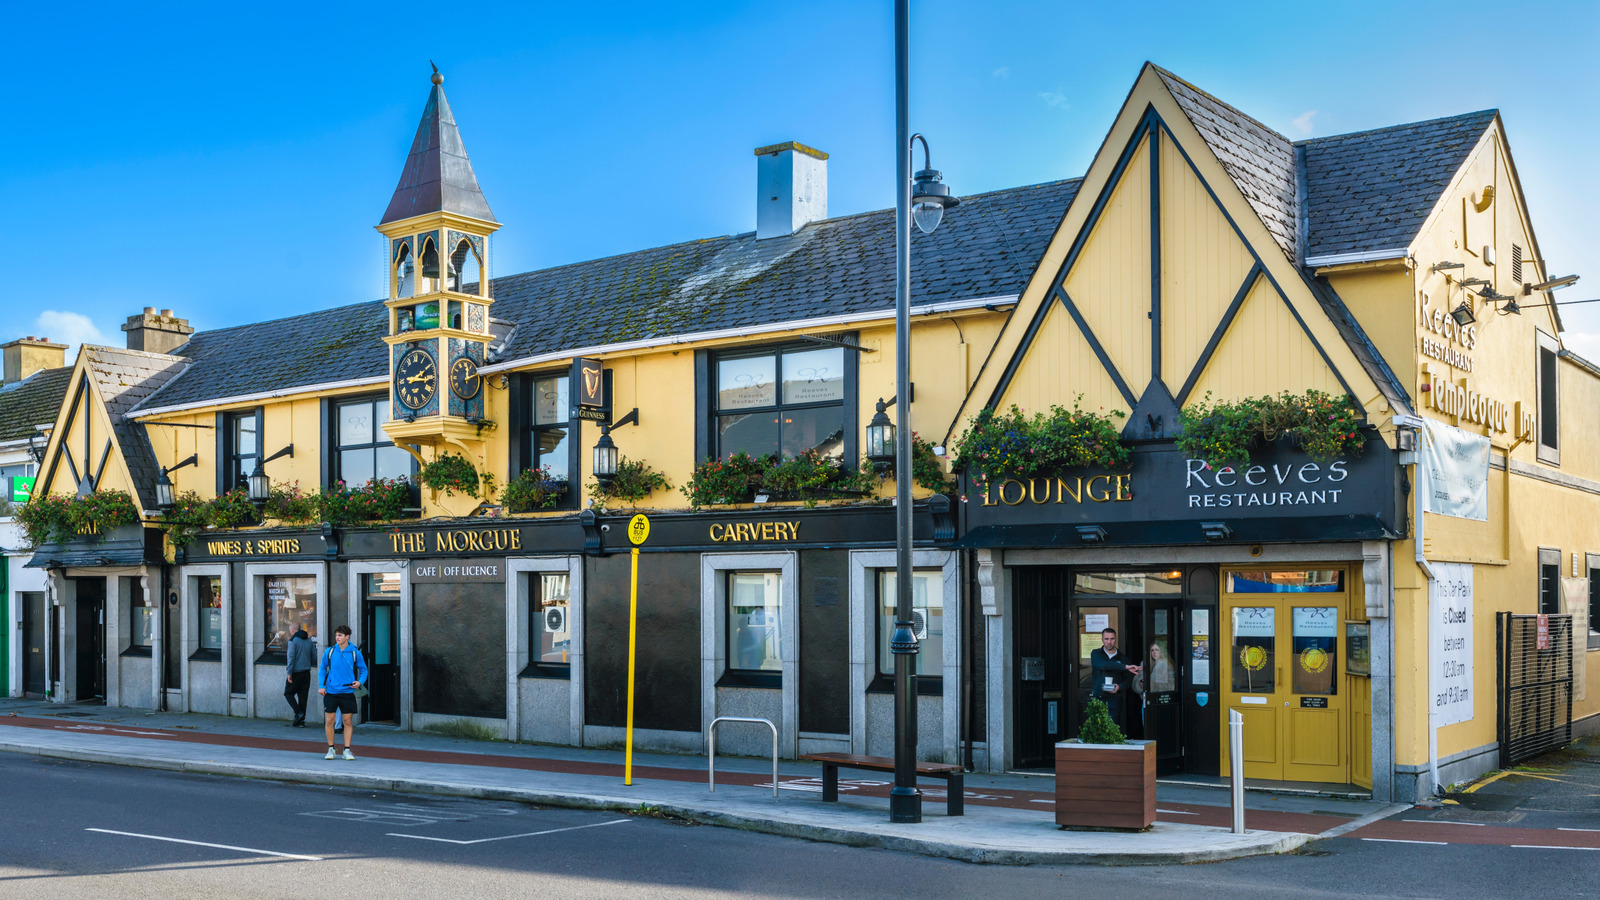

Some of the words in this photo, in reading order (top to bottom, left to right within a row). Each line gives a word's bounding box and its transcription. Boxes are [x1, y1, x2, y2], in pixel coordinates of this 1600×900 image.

[1421, 289, 1477, 350] Reeves
[1422, 336, 1475, 373] RESTAURANT
[1424, 362, 1510, 438] Templeogue
[1517, 400, 1537, 443] Inn
[1185, 459, 1348, 489] Reeves
[980, 473, 1133, 507] LOUNGE
[1188, 489, 1343, 508] RESTAURANT
[389, 532, 426, 553] THE
[435, 528, 522, 552] MORGUE
[709, 520, 801, 542] CARVERY
[207, 541, 242, 556] WINES
[245, 540, 254, 555] &
[257, 538, 300, 554] SPIRITS
[443, 566, 460, 576] OFF
[461, 565, 498, 576] LICENCE
[1436, 580, 1447, 597] This
[1448, 580, 1457, 597] Car
[1458, 580, 1471, 597] Park
[1442, 608, 1448, 624] is
[1448, 606, 1467, 624] Closed
[1443, 634, 1465, 652] between
[1436, 687, 1448, 707] and
